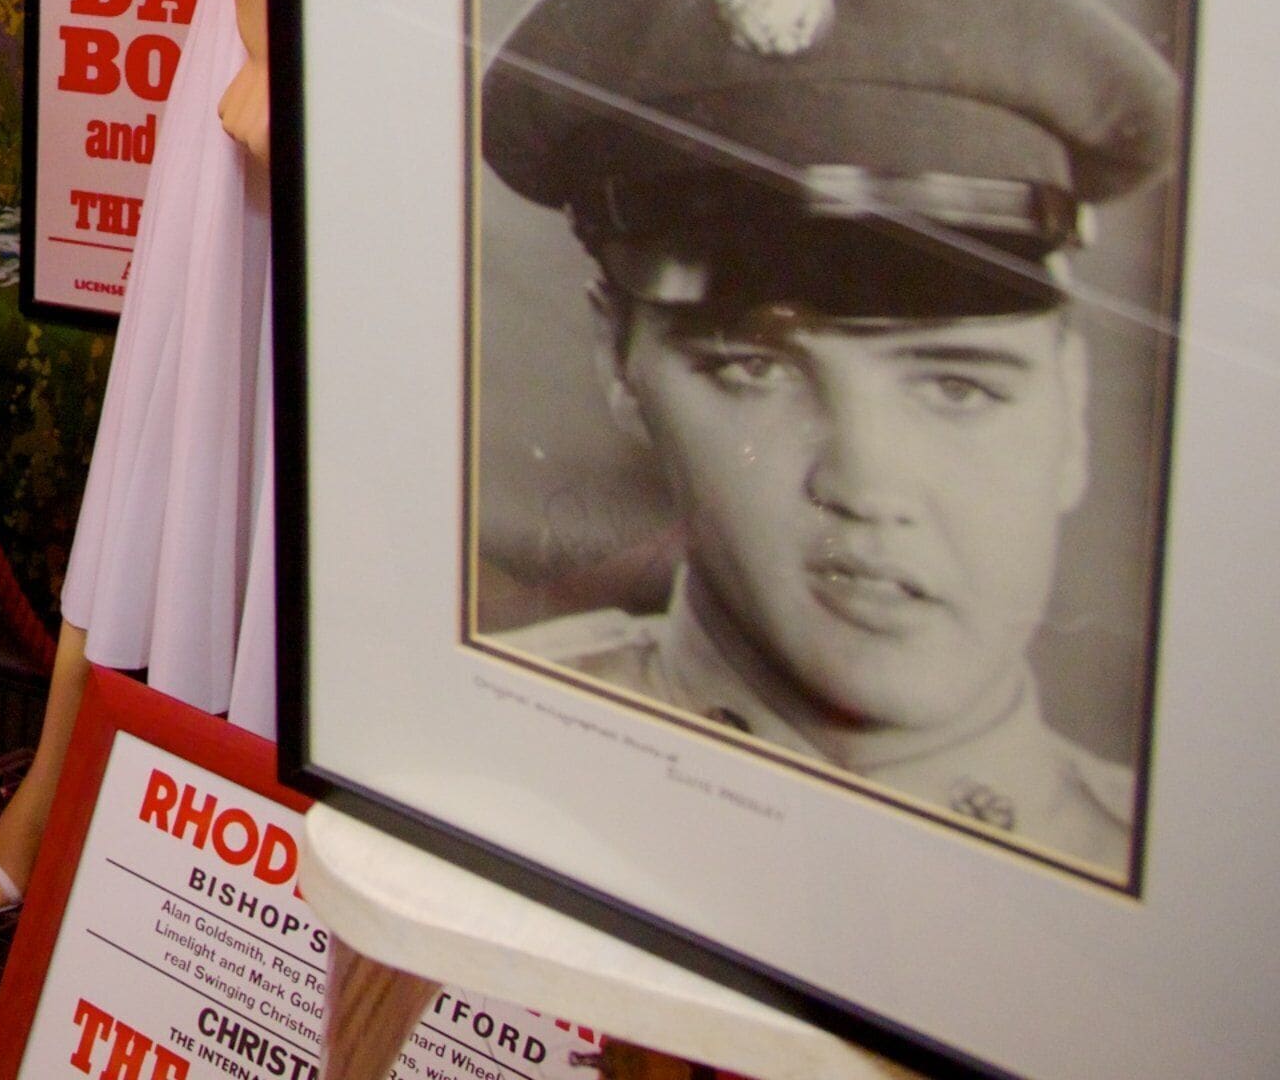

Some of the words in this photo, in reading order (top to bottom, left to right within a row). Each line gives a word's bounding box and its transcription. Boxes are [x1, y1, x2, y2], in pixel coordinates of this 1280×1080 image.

[58, 26, 181, 102] BO
[85, 114, 156, 165] and
[138, 768, 304, 901] RHOD
[161, 899, 191, 925] Alan
[195, 914, 267, 965] Goldsmith,
[273, 955, 301, 984] Reg
[305, 970, 326, 996] Re
[189, 867, 328, 954] BISHOP'S
[154, 919, 217, 967] Limelight
[219, 953, 246, 978] and
[248, 968, 286, 1001] Mark
[289, 991, 325, 1020] Gold
[163, 951, 191, 975] real
[194, 963, 257, 1010] Swinging
[259, 1000, 324, 1045] Christma
[170, 1026, 195, 1052] THE
[197, 1007, 320, 1080] CHRIST
[409, 1031, 446, 1058] nard
[433, 993, 546, 1065] TFORD
